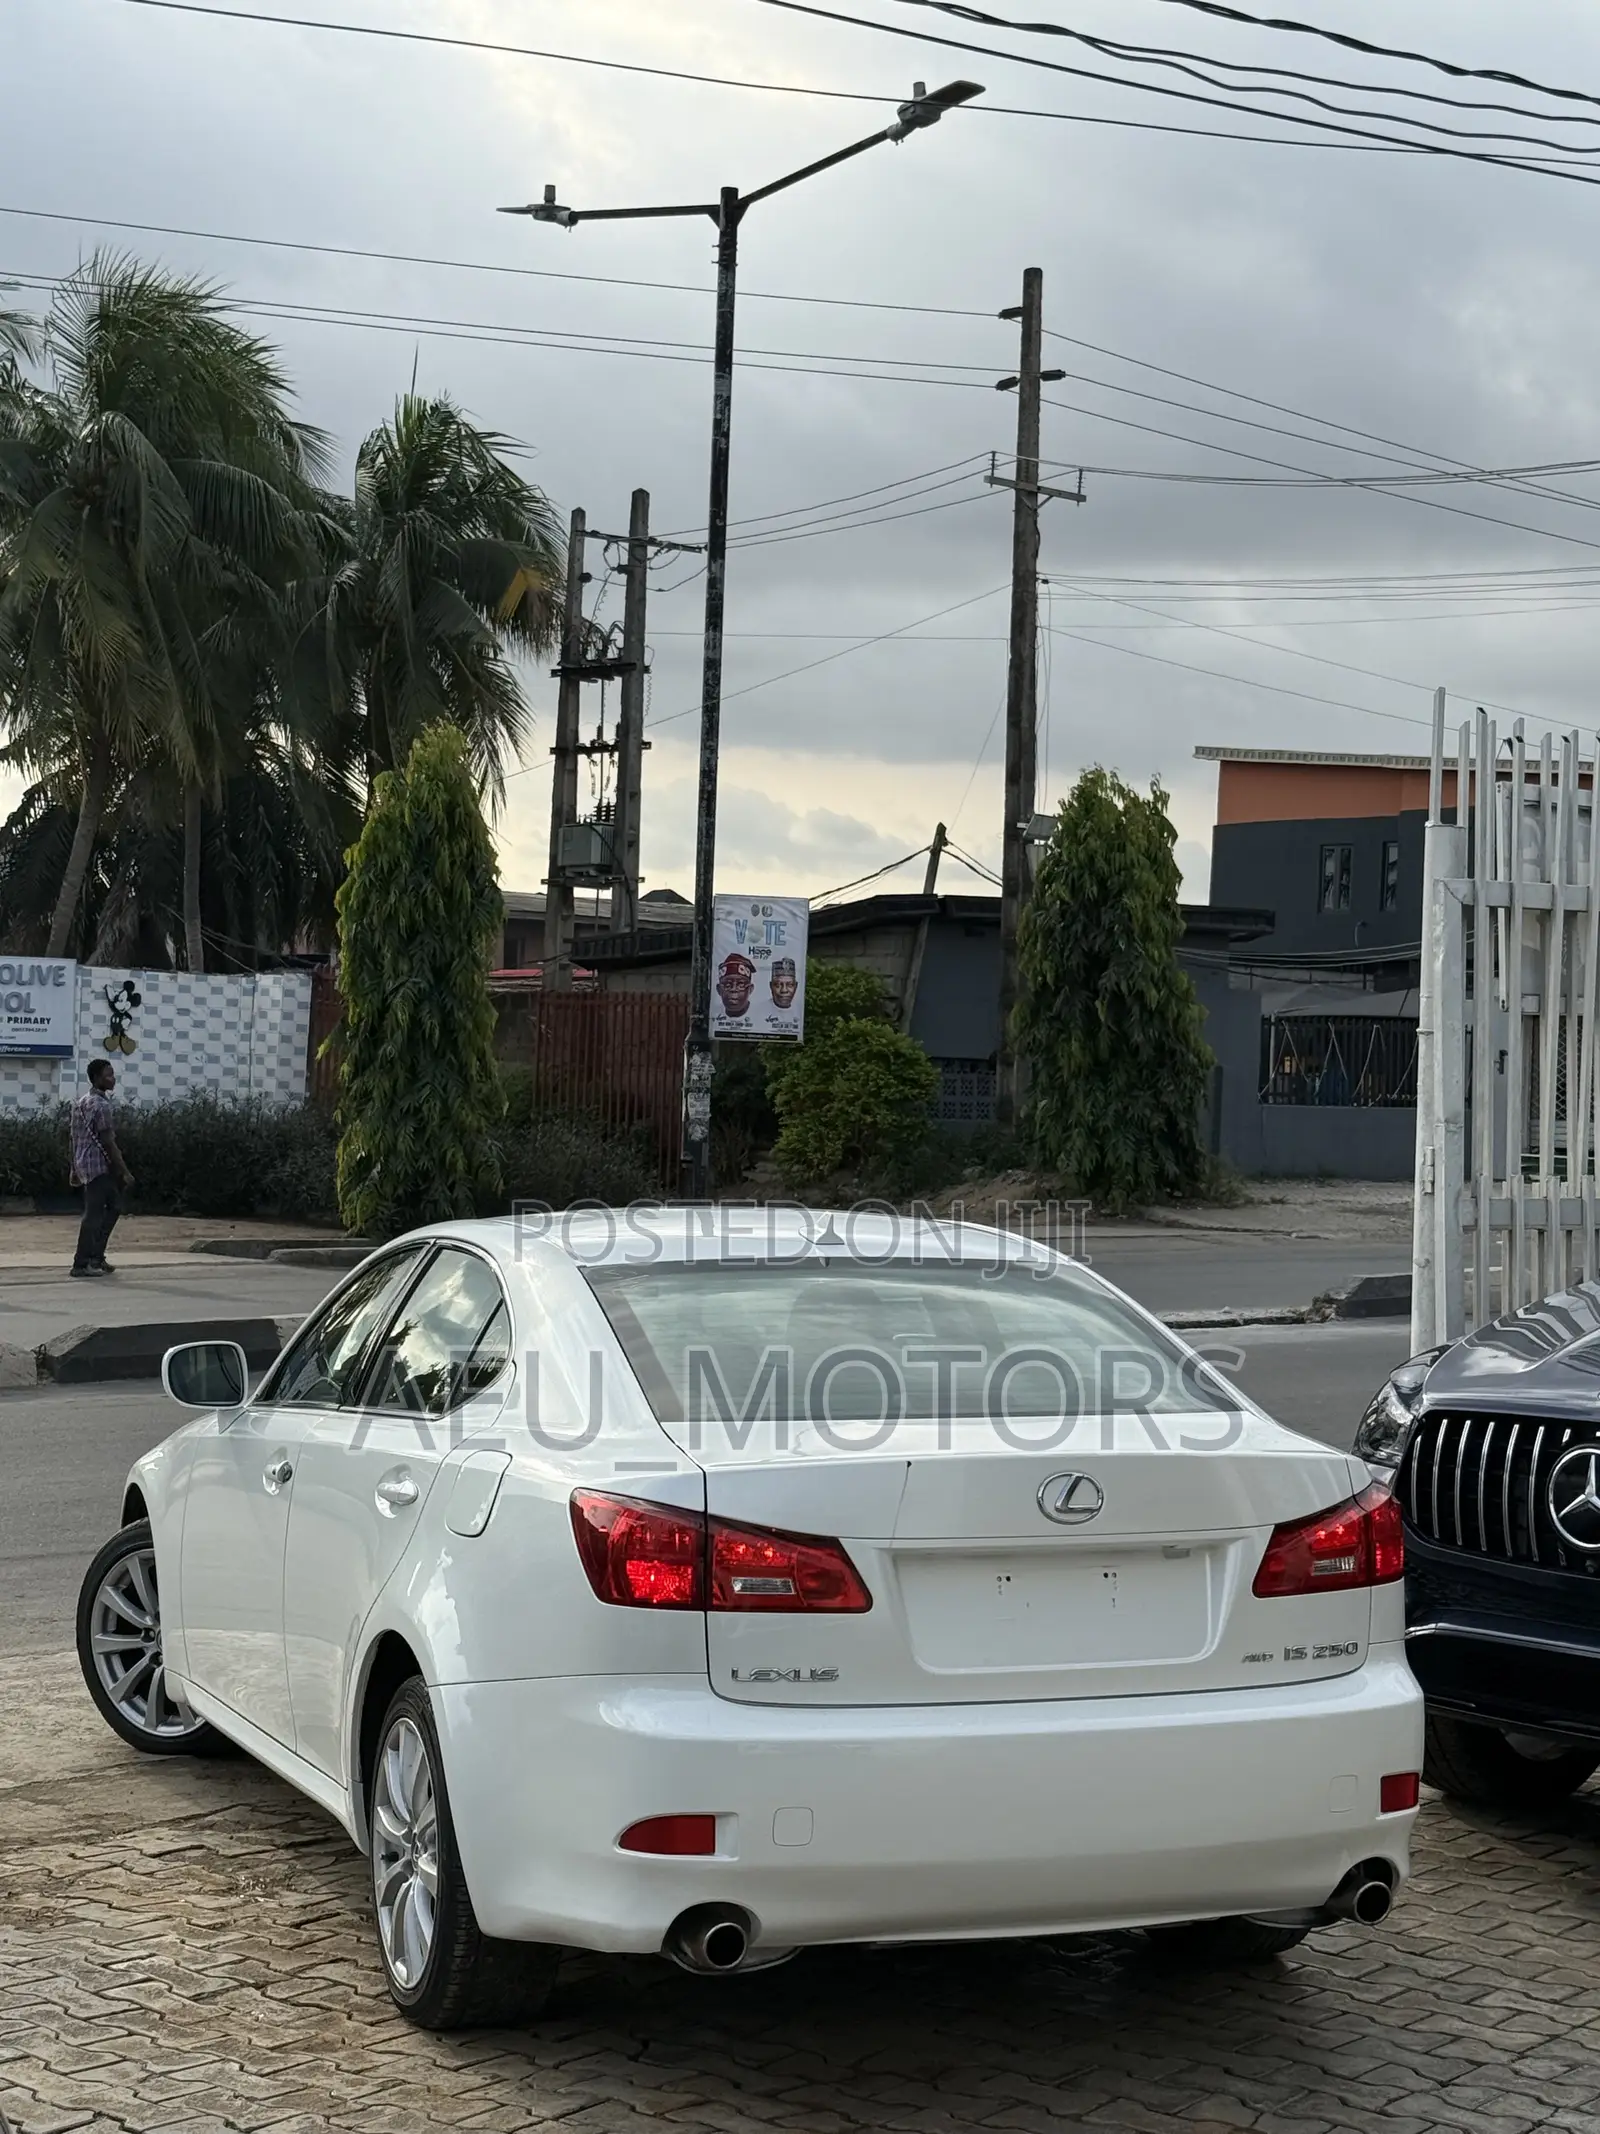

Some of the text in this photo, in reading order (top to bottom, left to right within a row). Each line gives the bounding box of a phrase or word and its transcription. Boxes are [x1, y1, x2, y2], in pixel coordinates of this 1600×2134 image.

[0, 963, 67, 987] OLIVE
[7, 1016, 52, 1025] PRIMARY
[1283, 1645, 1308, 1661] IS
[1312, 1640, 1359, 1660] 250
[731, 1667, 840, 1683] LEXUS
